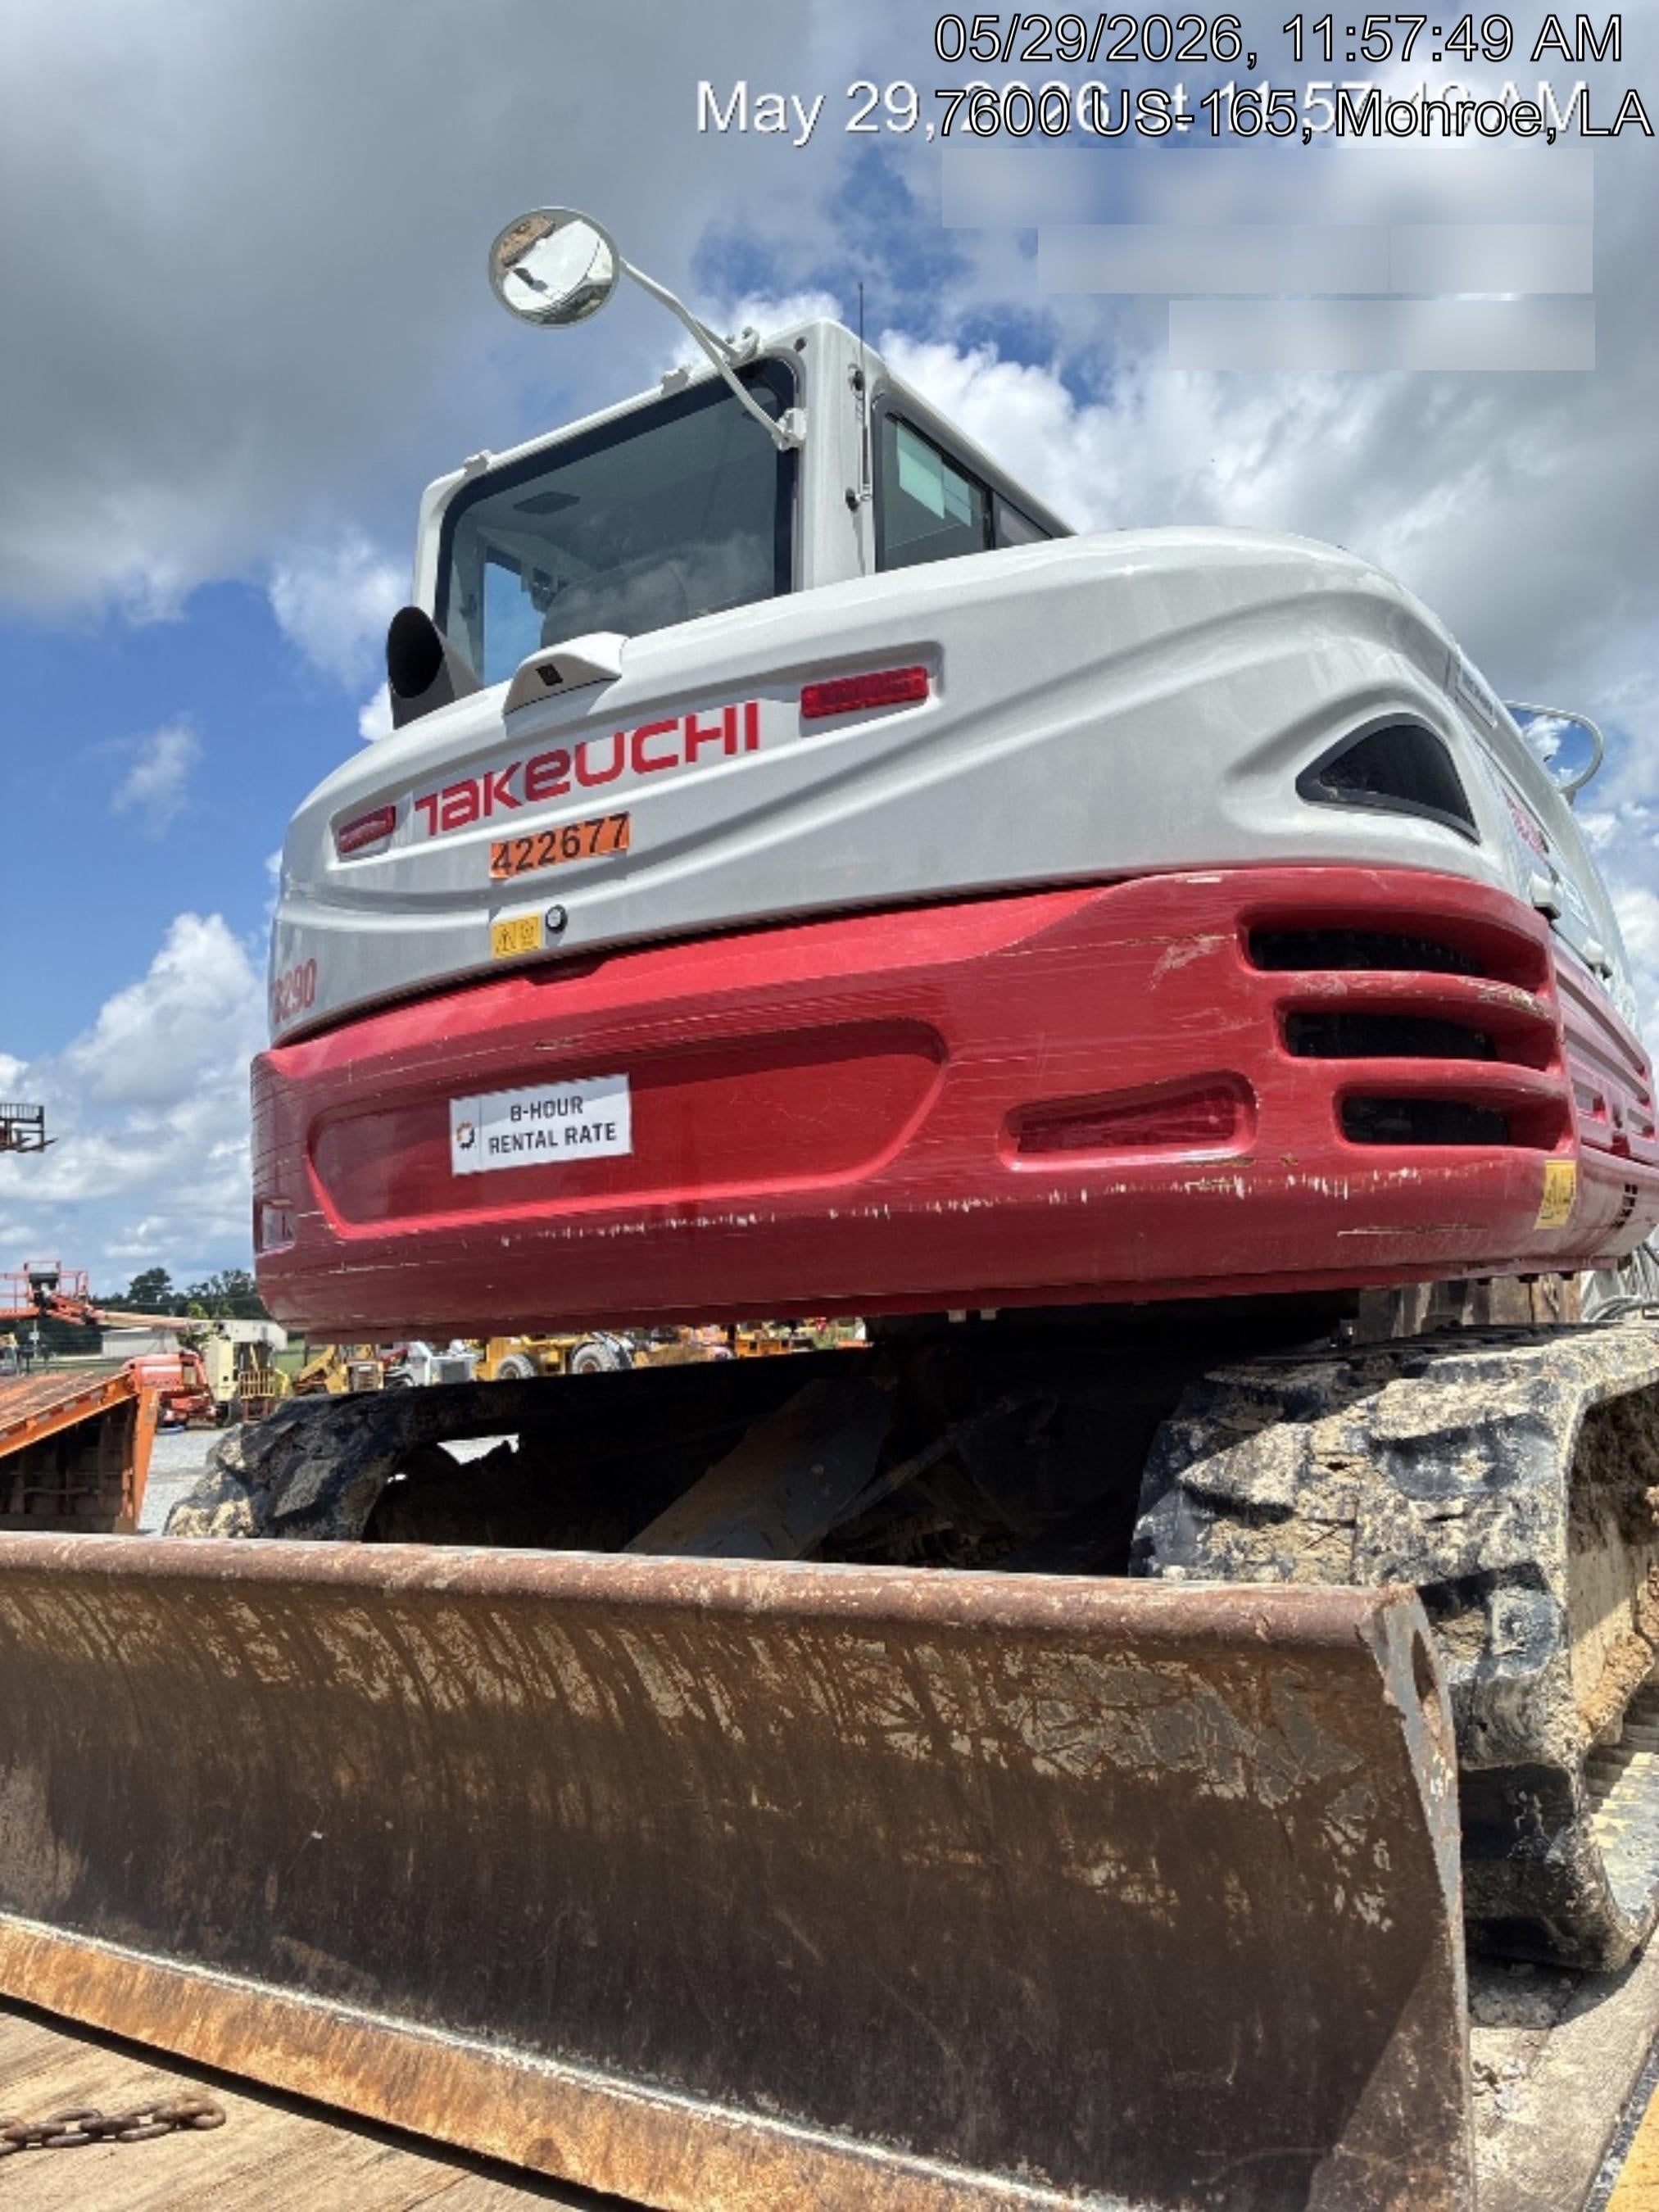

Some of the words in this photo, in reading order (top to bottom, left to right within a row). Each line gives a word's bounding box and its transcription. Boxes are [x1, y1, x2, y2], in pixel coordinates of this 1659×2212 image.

[492, 811, 630, 875] 422677
[488, 1129, 559, 1155] RENTAL
[564, 1122, 617, 1146] RATE
